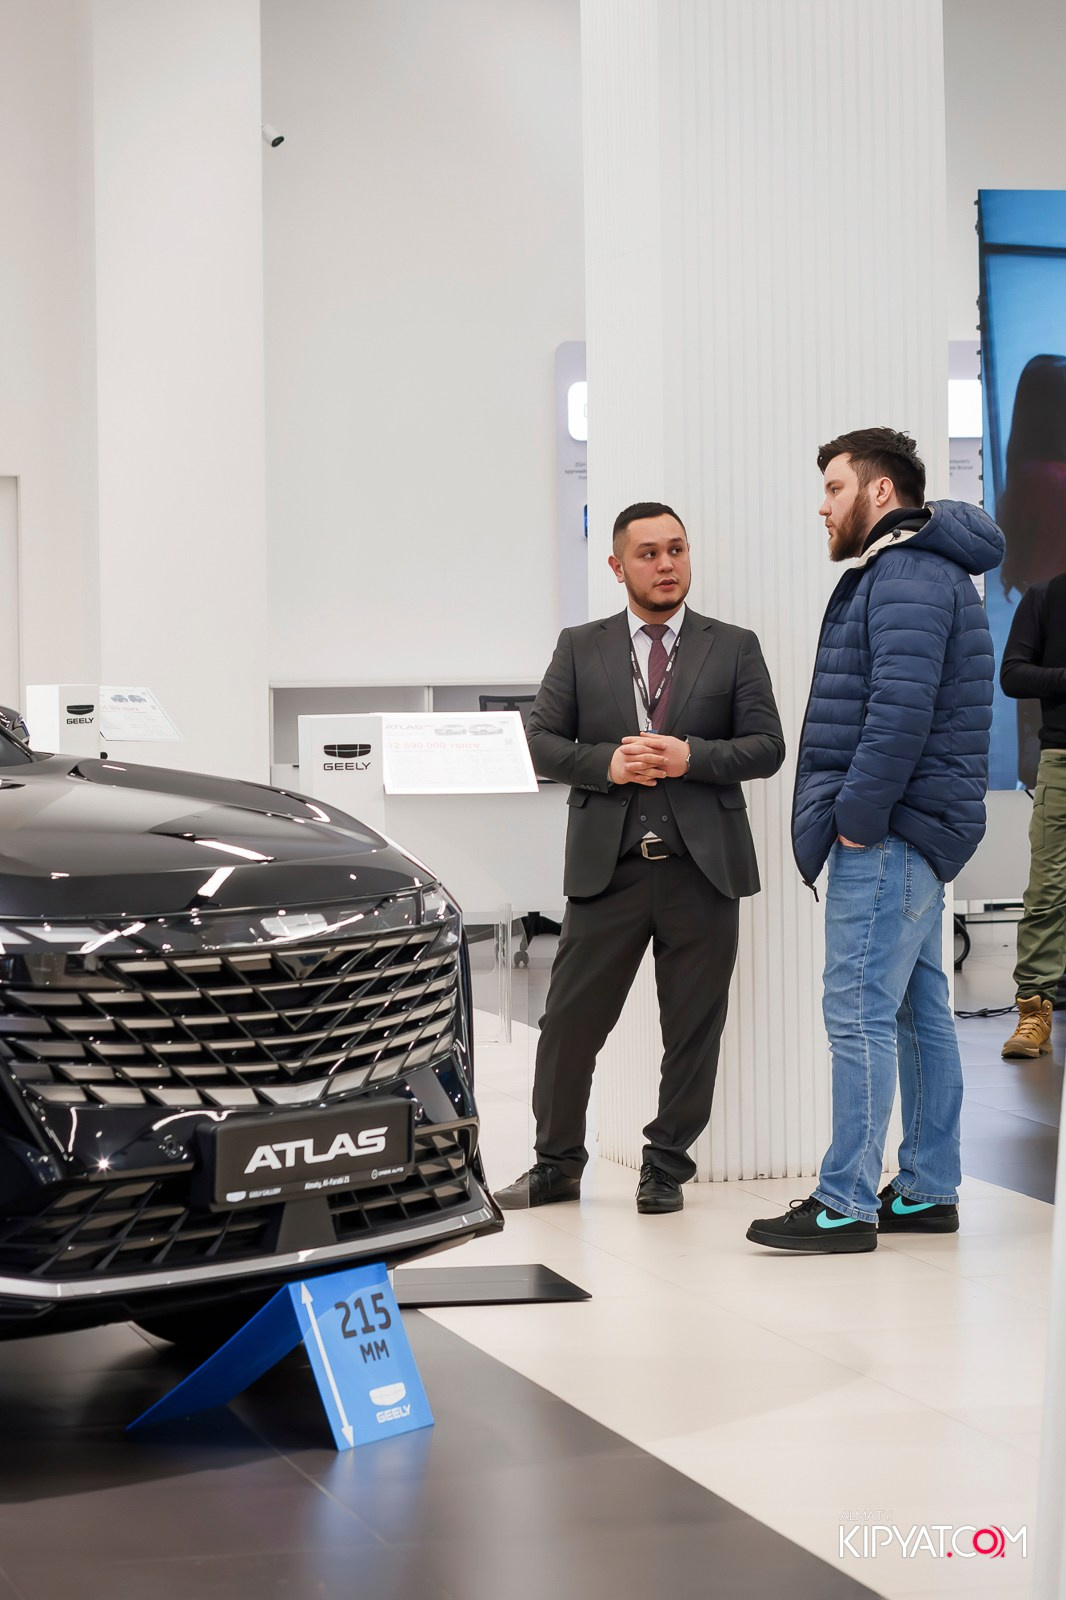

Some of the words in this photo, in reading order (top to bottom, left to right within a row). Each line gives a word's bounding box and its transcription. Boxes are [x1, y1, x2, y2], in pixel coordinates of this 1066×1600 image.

[66, 717, 94, 725] GEELY
[323, 762, 371, 771] GEELY
[243, 1126, 389, 1174] ATLAS
[334, 1292, 392, 1339] 215
[375, 1404, 411, 1424] GEELY
